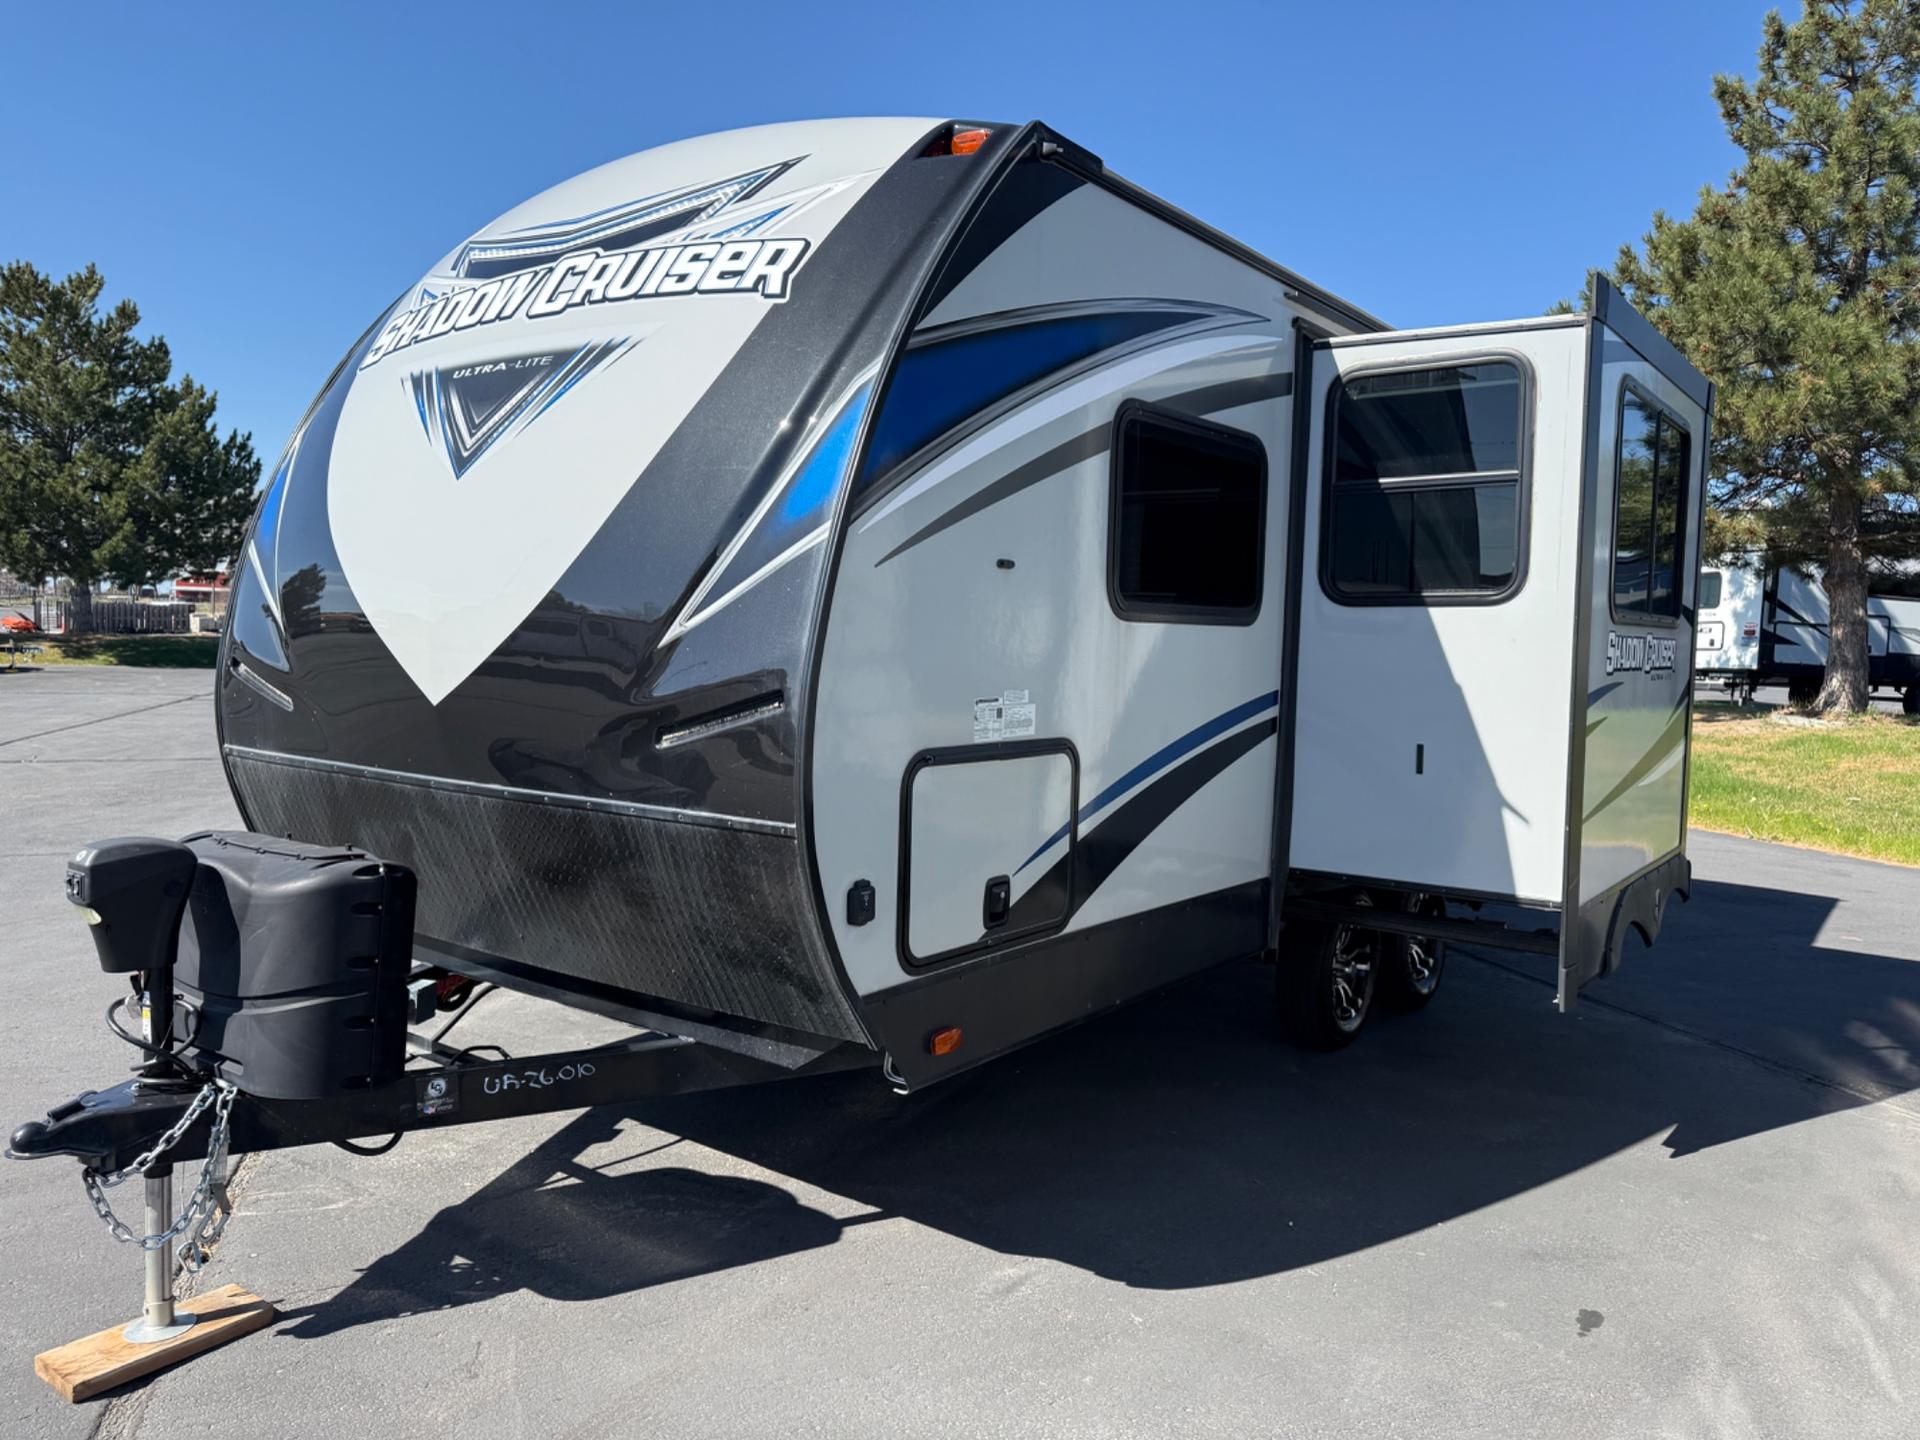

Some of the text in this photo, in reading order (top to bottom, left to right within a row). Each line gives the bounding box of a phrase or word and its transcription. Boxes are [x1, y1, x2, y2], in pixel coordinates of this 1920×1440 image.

[359, 239, 811, 372] SHADOW CRUISER
[452, 355, 554, 379] ULTRA-LITE
[1606, 630, 1643, 676] SHADOW
